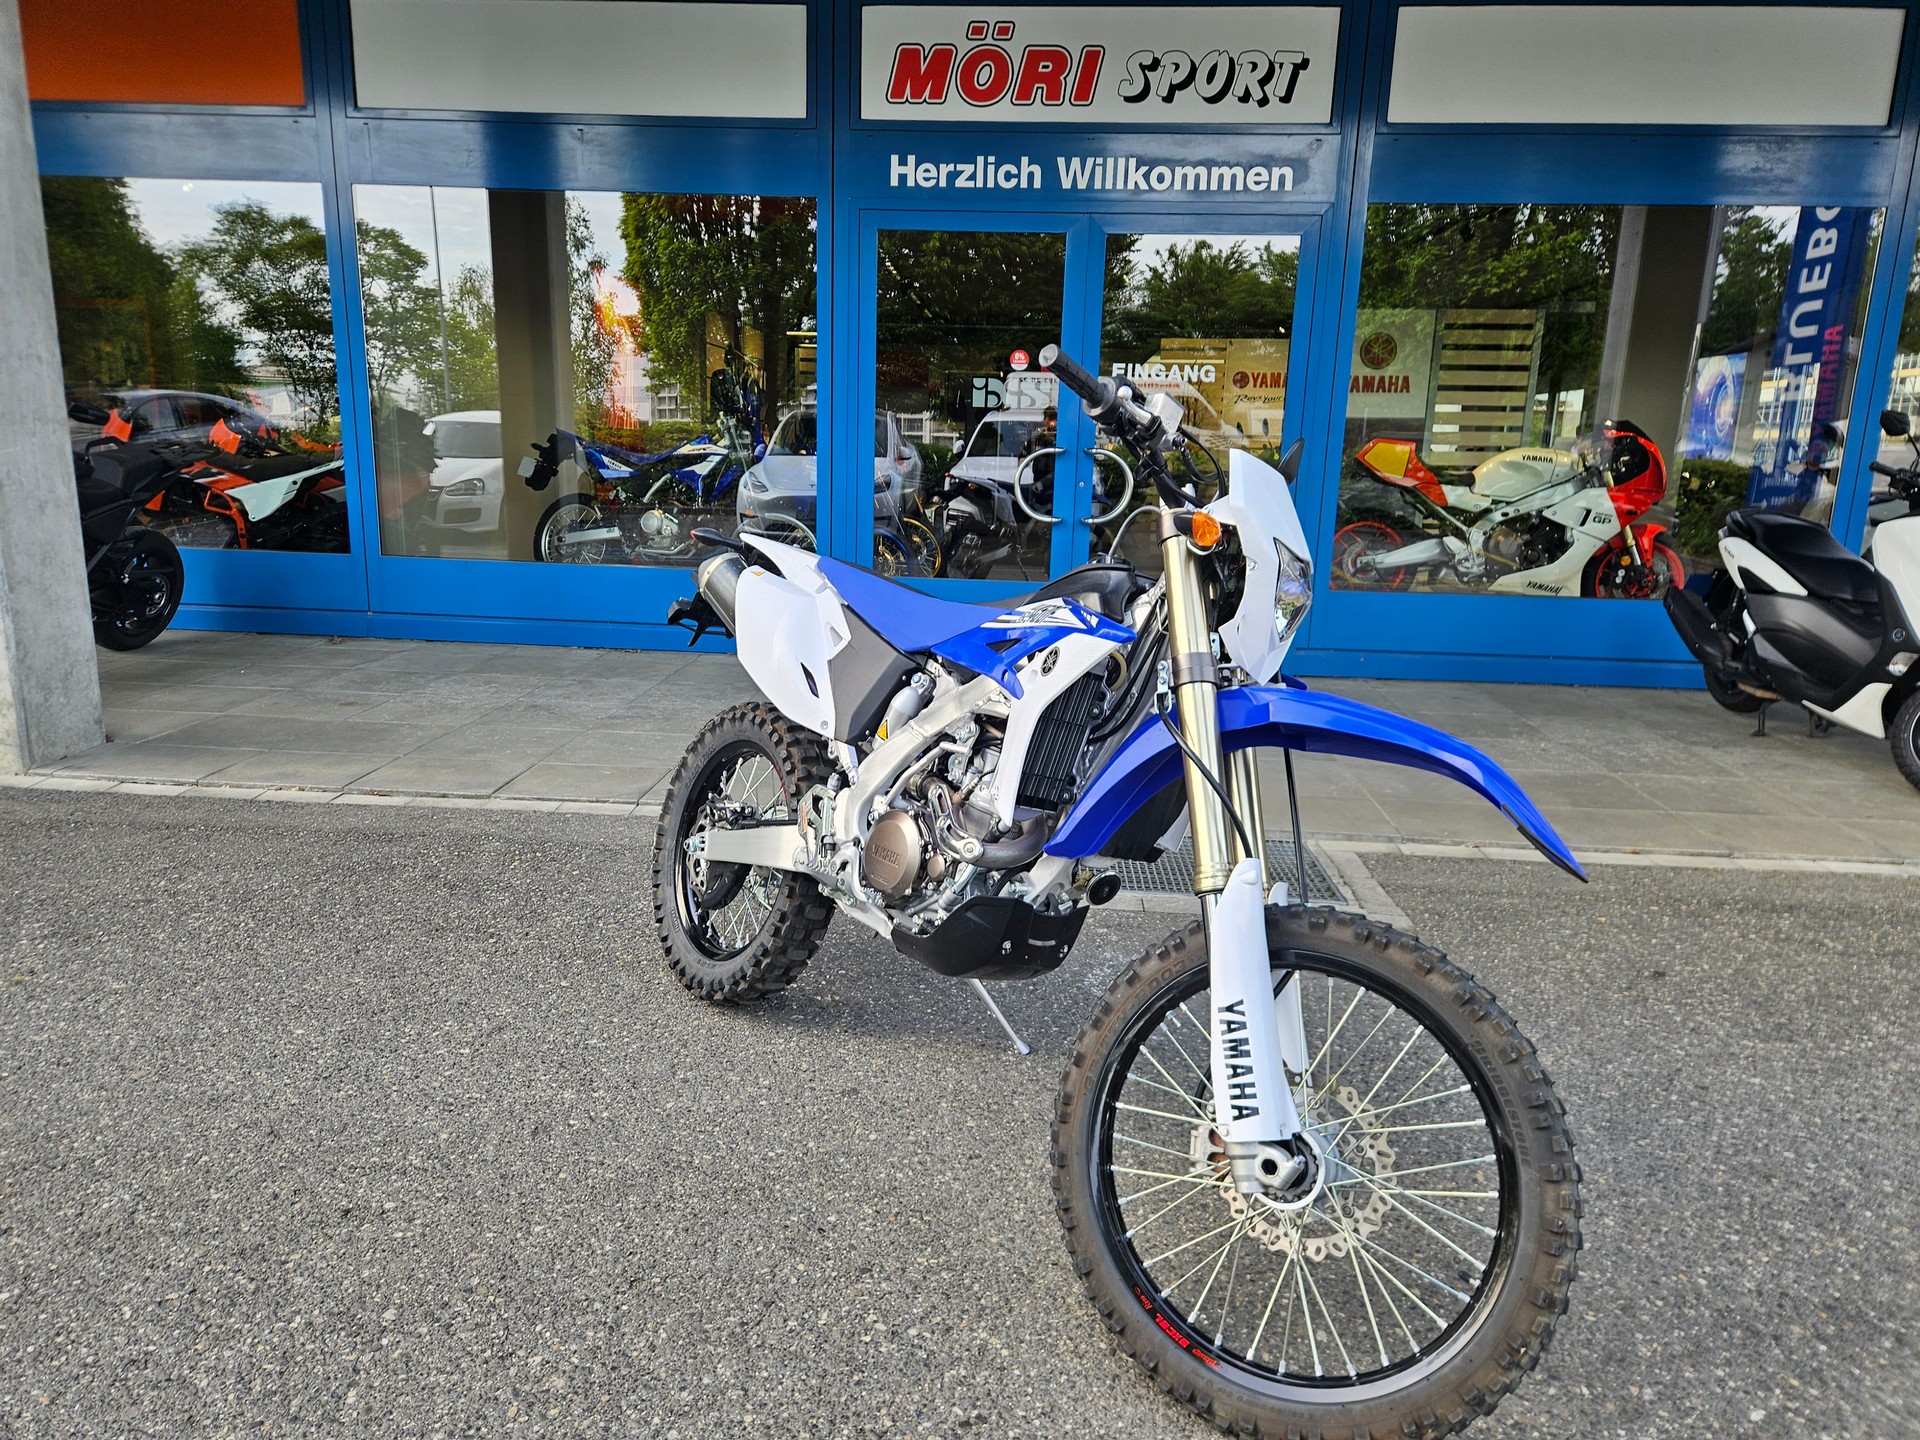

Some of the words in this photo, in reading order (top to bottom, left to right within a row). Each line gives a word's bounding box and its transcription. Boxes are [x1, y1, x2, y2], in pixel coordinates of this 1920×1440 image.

[886, 20, 1105, 107] MÖRI
[1117, 49, 1310, 108] SPORT
[890, 153, 1042, 189] Herzlich
[1056, 156, 1294, 192] Willkommen
[1349, 375, 1411, 393] AMAHA
[1521, 454, 1554, 464] YAMAHA
[1526, 580, 1562, 596] YAMAHA
[1217, 997, 1261, 1123] YAMAHA
[1155, 1312, 1190, 1348] EXCEL
